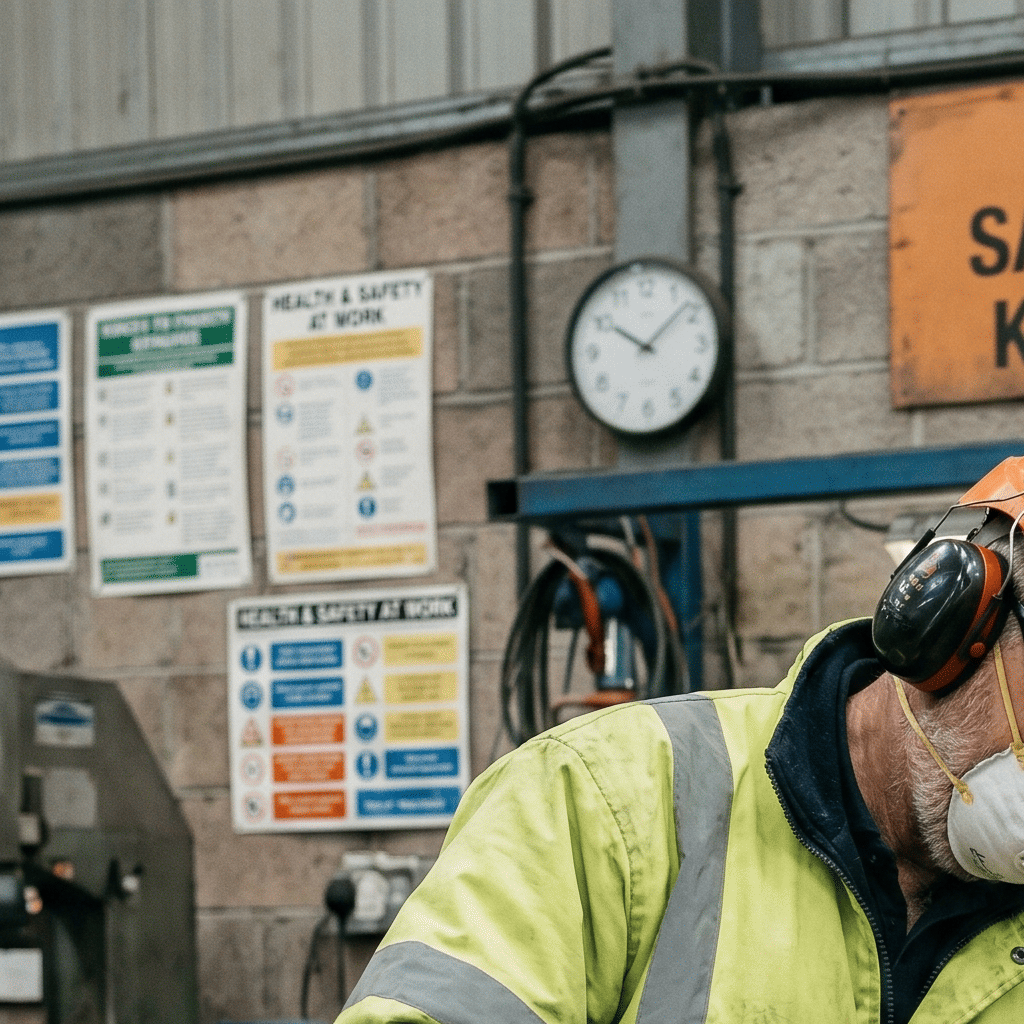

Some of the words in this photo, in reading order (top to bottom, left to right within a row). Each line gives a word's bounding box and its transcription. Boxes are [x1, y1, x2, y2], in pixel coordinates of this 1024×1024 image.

[272, 289, 334, 311] HEALTH
[359, 280, 422, 301] SAFETY
[308, 312, 327, 330] AT
[335, 308, 385, 328] WORK
